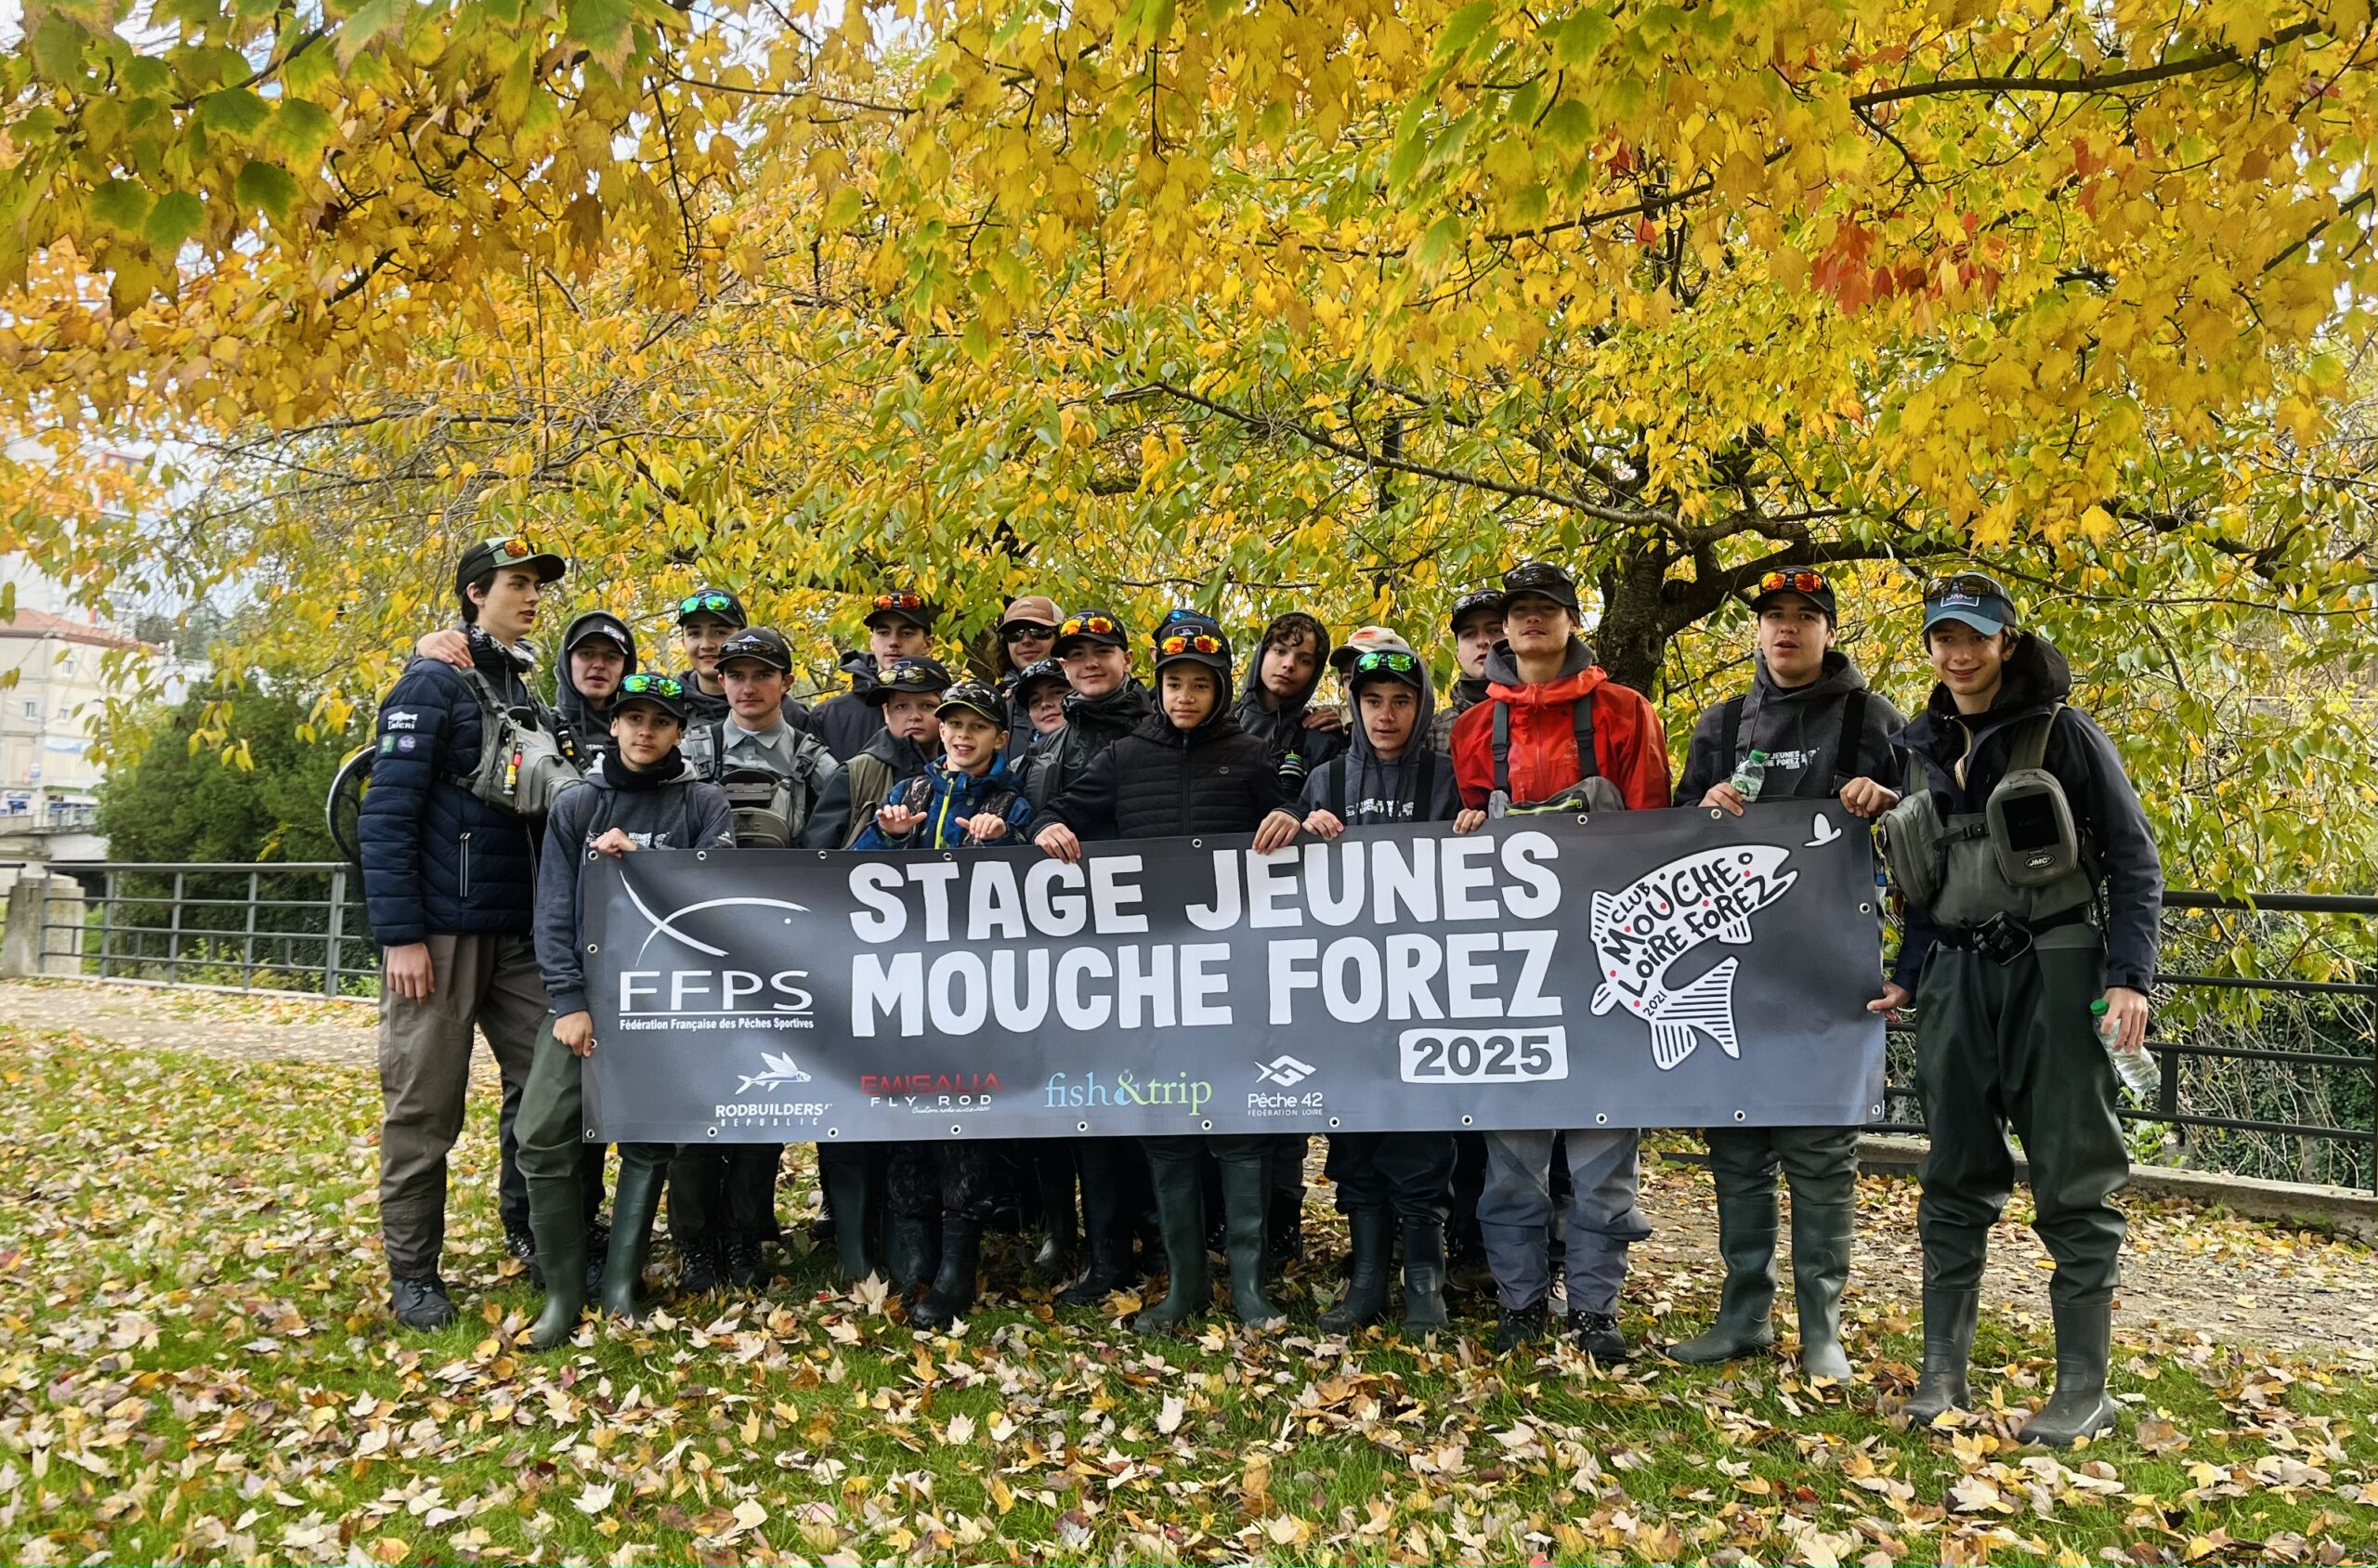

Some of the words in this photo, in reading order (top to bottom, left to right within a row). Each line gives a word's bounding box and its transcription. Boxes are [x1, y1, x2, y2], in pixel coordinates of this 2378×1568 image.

[849, 855, 1149, 944] STAGE
[1185, 831, 1561, 931] JEUNES
[1612, 882, 1651, 923] CLUB
[1684, 875, 1787, 938] FOREZ
[1602, 857, 1741, 965] MOUCHE
[620, 970, 814, 1012] FFPS
[851, 943, 1233, 1038] MOUCHE
[1268, 930, 1562, 1025] FOREZ
[1643, 990, 1667, 1016] 2021
[620, 1018, 668, 1030] Fédération
[670, 1018, 717, 1032] Française
[719, 1017, 737, 1029] des
[738, 1017, 772, 1028] Pêches
[773, 1017, 815, 1031] Sportives
[1413, 1035, 1552, 1077] 2025
[861, 1072, 1002, 1095] EMISALIA
[870, 1096, 917, 1107] FLY
[938, 1095, 992, 1105] ROD
[1248, 1091, 1298, 1108] Pêche
[1300, 1091, 1324, 1107] 42
[720, 1117, 818, 1127] REPUBLIC
